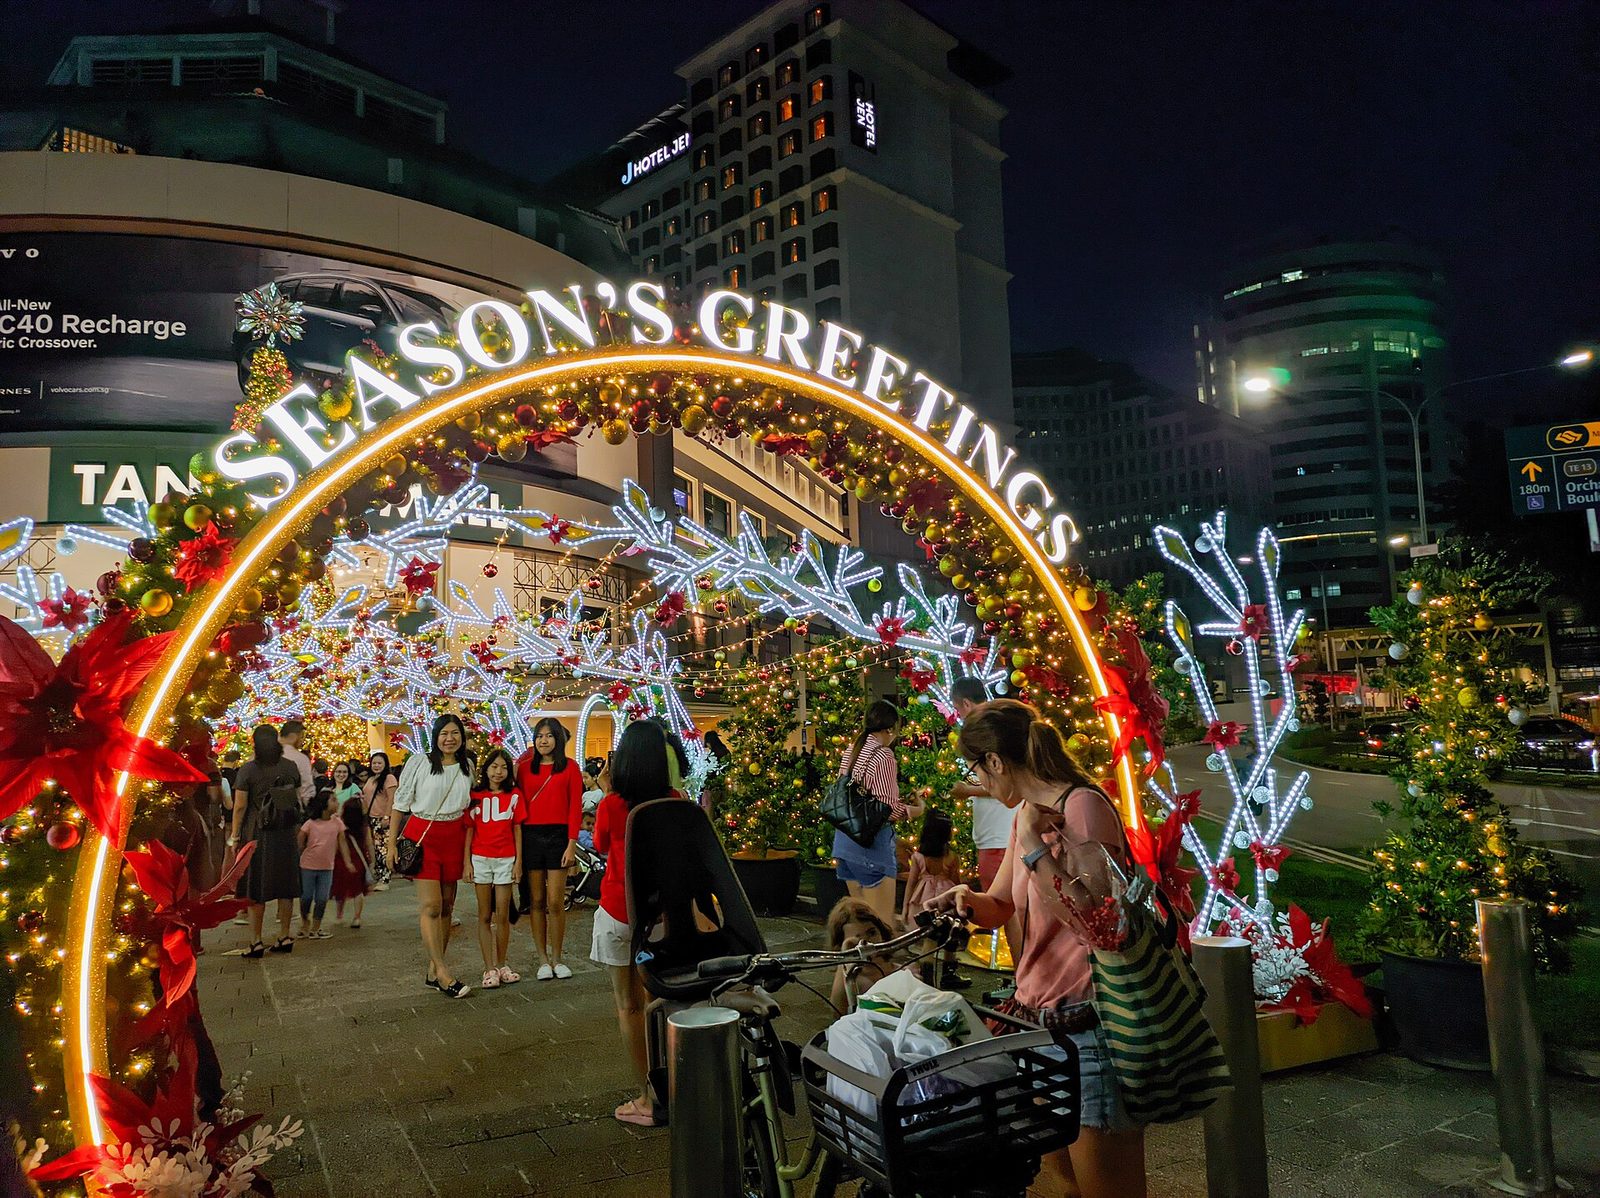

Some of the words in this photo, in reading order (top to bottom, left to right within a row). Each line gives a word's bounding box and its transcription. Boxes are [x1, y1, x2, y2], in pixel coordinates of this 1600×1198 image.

[856, 97, 866, 127] JEN
[865, 101, 876, 147] HOTEL
[633, 145, 671, 178] HOTEL
[0, 314, 54, 334] C40
[62, 314, 187, 340] Recharge
[18, 336, 98, 349] Crossover.
[214, 281, 674, 510] SEASON'S
[699, 290, 1081, 564] GREETINGS
[1568, 464, 1580, 473] TE
[1581, 463, 1592, 472] 13
[1520, 484, 1550, 495] 180m
[1567, 490, 1600, 505] Boul
[909, 1058, 939, 1077] THULE
